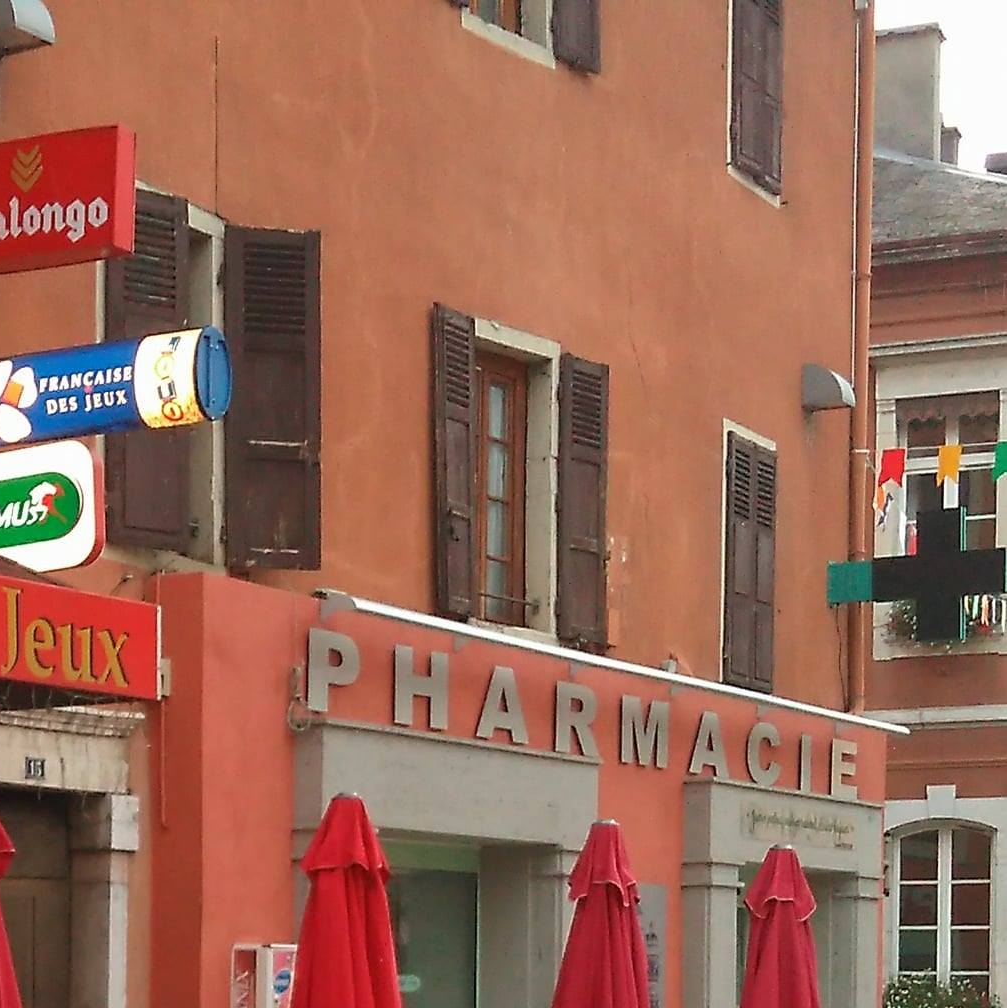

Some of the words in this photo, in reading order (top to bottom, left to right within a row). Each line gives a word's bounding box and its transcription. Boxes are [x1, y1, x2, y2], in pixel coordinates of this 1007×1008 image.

[38, 365, 133, 394] FRANÇAISE
[45, 396, 78, 415] DES
[84, 389, 128, 412] JEUX
[0, 585, 130, 688] Jeux
[305, 627, 859, 800] PHARMACIE
